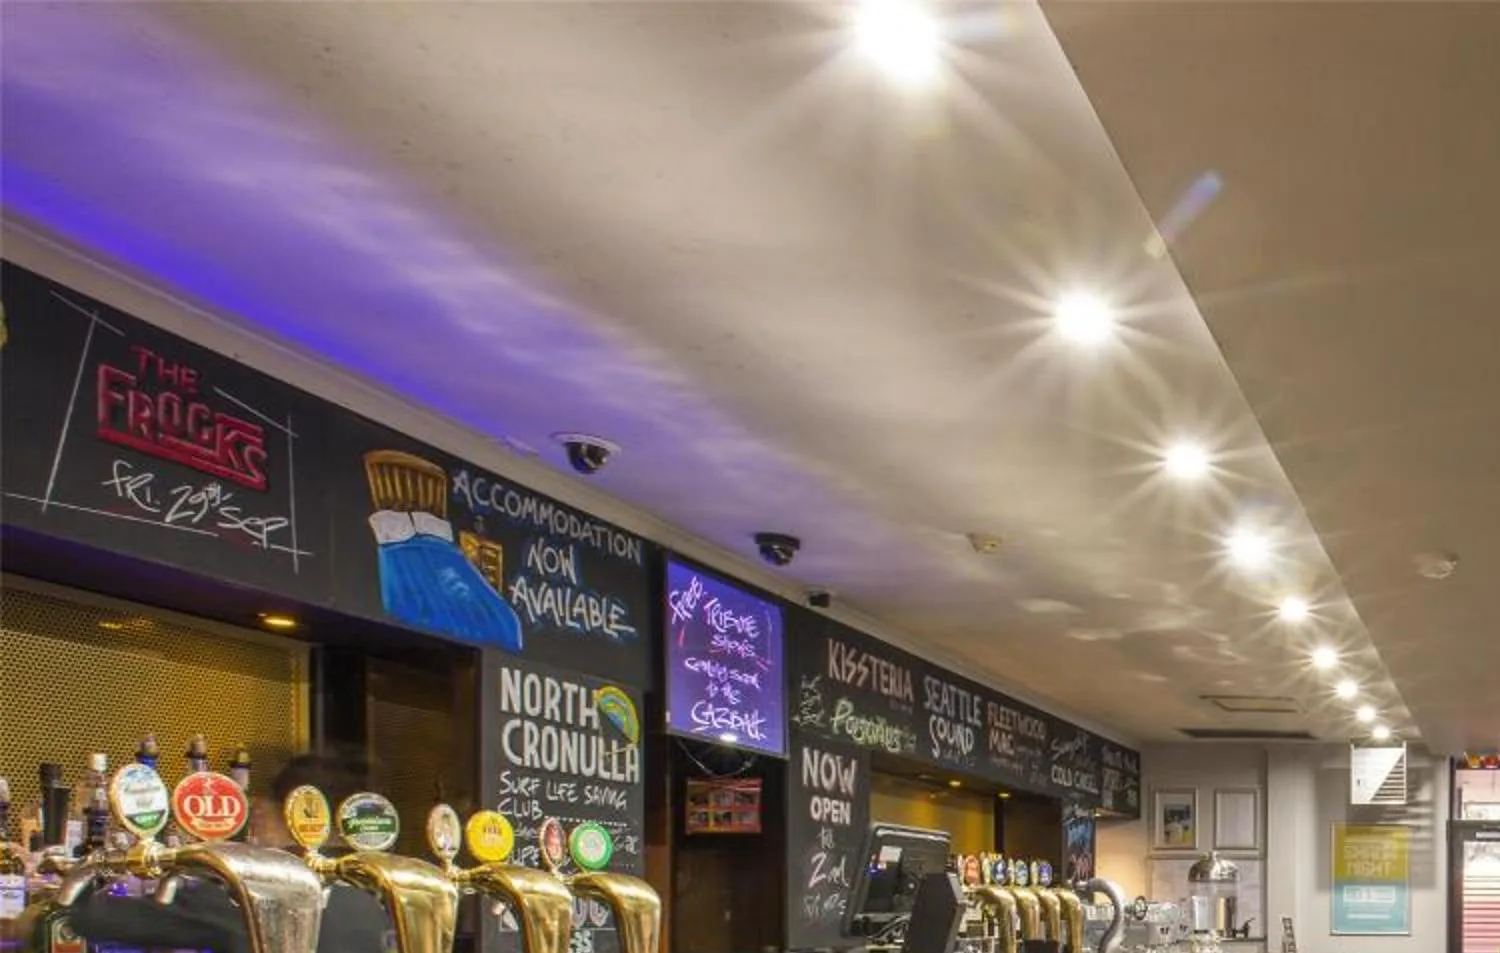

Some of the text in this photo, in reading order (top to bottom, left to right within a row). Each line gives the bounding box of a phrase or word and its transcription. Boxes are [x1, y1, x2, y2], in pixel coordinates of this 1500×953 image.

[129, 345, 199, 393] THE
[97, 363, 268, 485] FROCKS
[453, 469, 643, 567] ACCOMMODATION
[528, 537, 577, 584] NOW
[509, 575, 636, 637] AVAILABLE
[827, 637, 914, 702] KISSTERIA
[501, 667, 600, 729] NORTH
[924, 675, 982, 729] SEATTLE
[502, 718, 640, 783] CRONULLA
[930, 713, 974, 758] SOUND
[500, 771, 541, 797] SURF
[546, 780, 579, 803] LIFE
[803, 747, 857, 796] NOW
[184, 794, 241, 817] OLD
[497, 797, 543, 820] CLUB
[810, 796, 851, 825] OPEN
